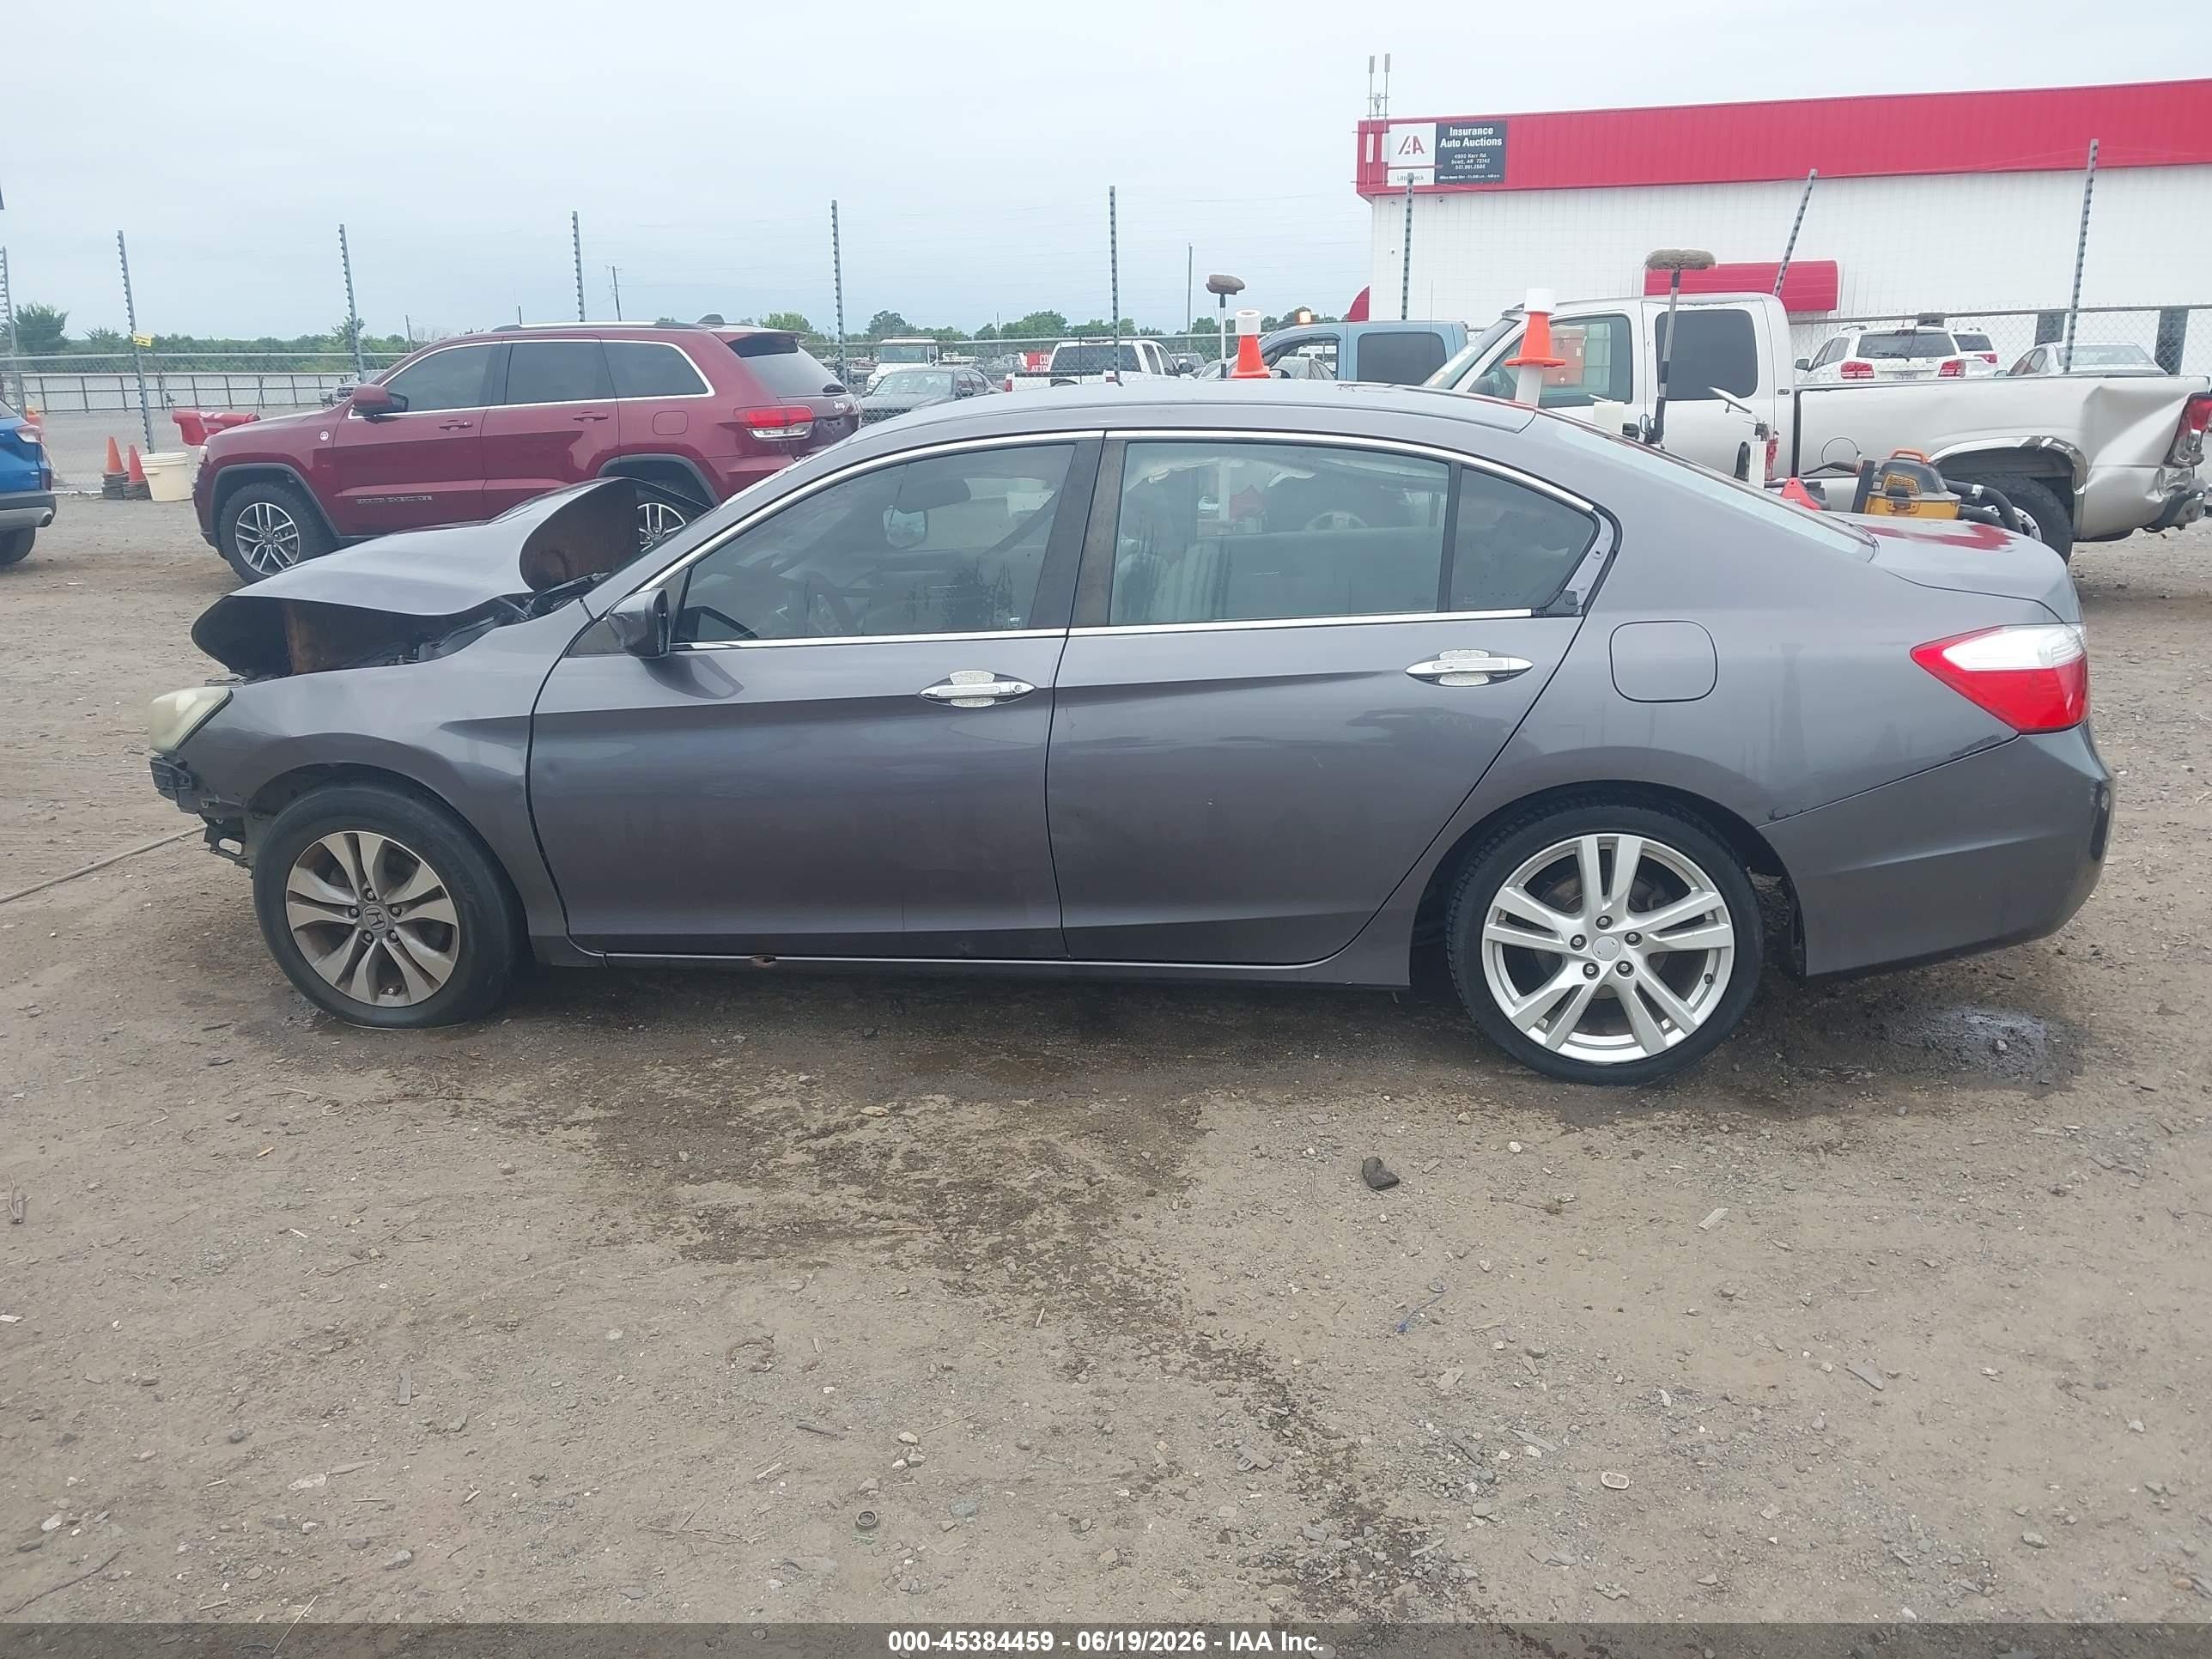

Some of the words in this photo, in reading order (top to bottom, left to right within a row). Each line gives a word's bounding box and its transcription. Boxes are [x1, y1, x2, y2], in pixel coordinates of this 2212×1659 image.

[1449, 126, 1494, 137] Insurance
[1439, 137, 1461, 148] Auto
[1462, 137, 1503, 147] Auctions
